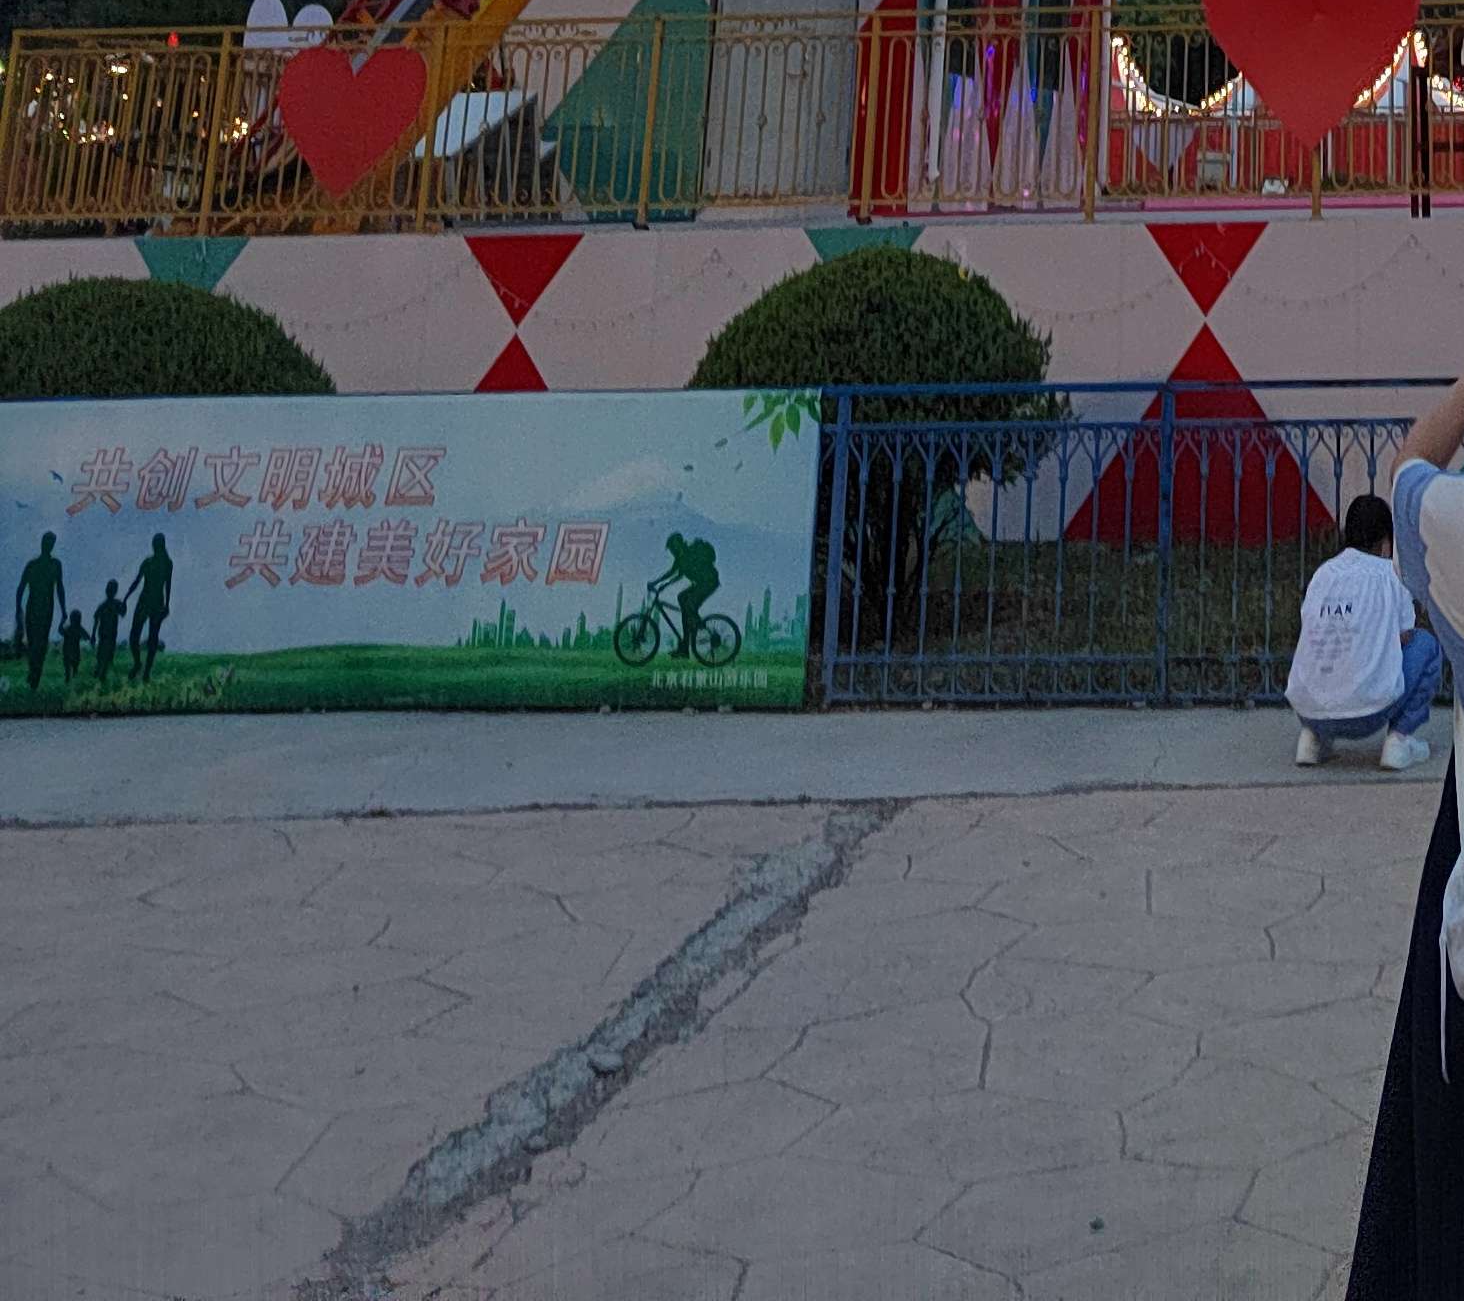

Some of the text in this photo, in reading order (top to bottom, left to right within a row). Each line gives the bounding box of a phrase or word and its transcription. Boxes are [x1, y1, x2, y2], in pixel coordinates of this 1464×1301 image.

[66, 444, 447, 516] 共创文明城区
[224, 518, 611, 590] 共建美好家园
